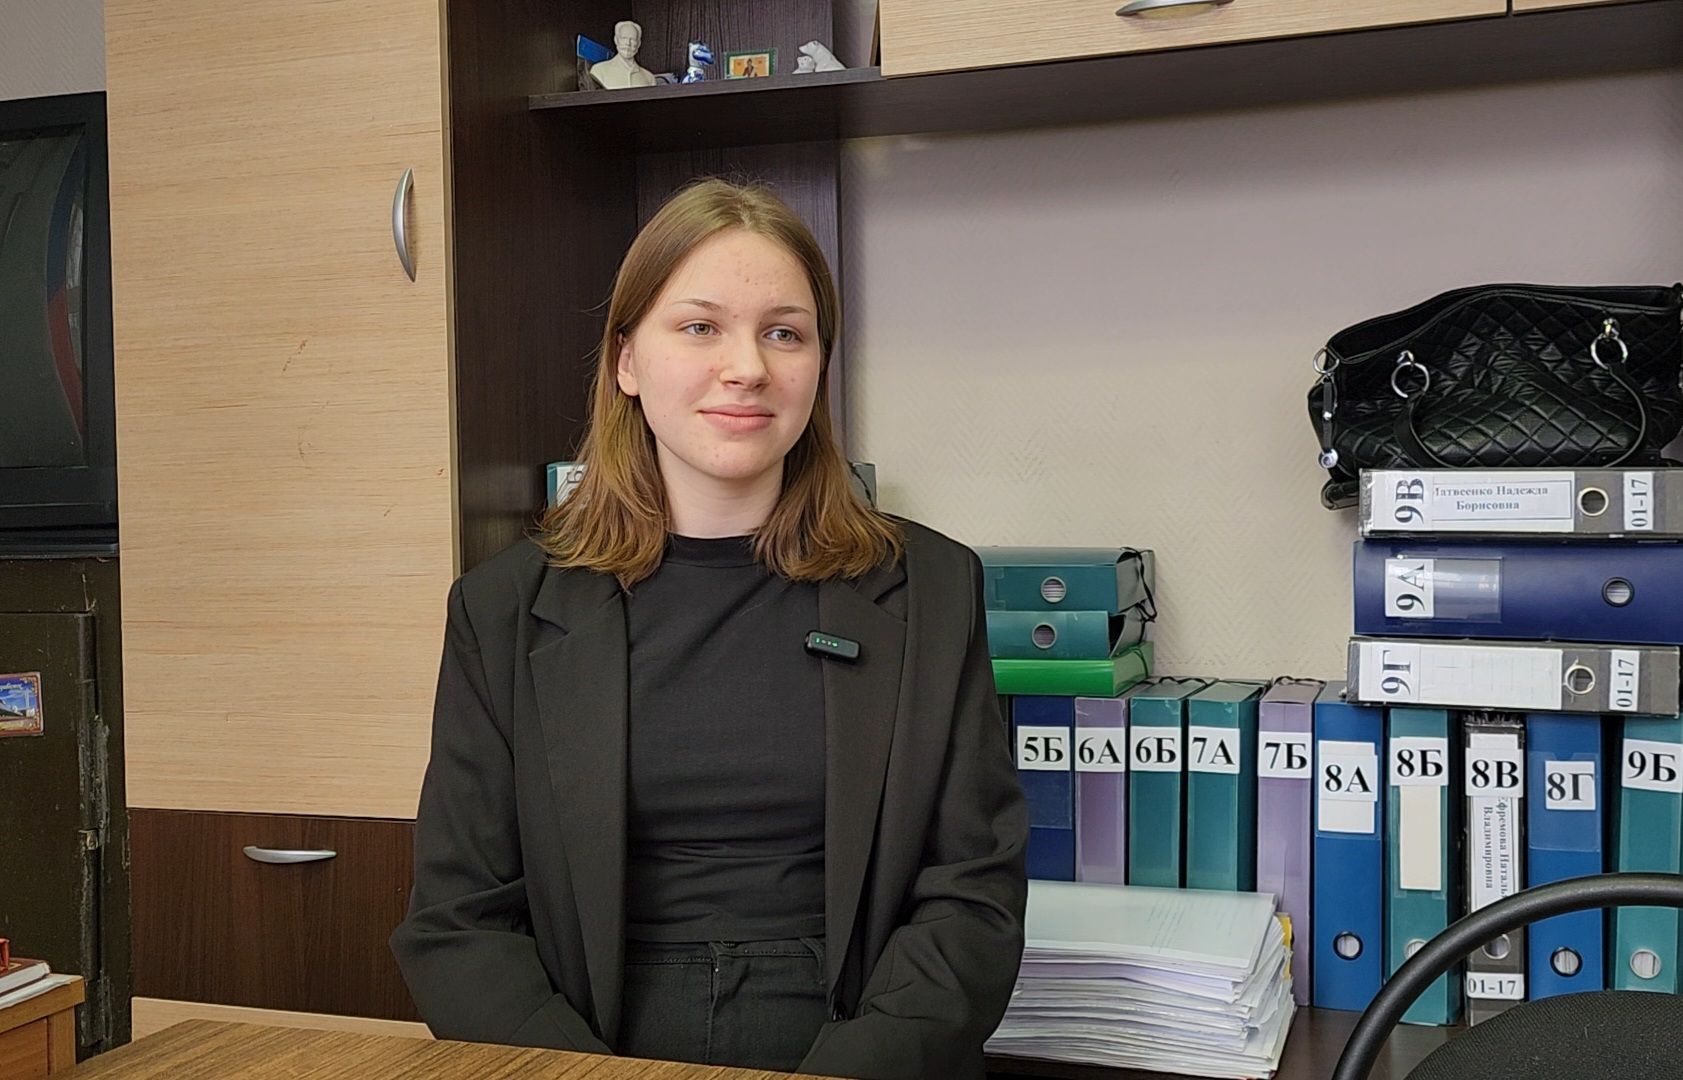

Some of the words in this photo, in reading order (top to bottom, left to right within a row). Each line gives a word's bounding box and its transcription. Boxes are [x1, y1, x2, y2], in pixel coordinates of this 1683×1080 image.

[1394, 478, 1424, 524] 9В
[1496, 485, 1548, 497] Надежда
[1631, 478, 1648, 528] 01-17
[1456, 500, 1519, 512] Борисовна
[1396, 564, 1426, 611] 9А
[1381, 650, 1412, 695] 9Г
[1616, 658, 1635, 708] 01-17
[1023, 736, 1064, 763] 5Б
[1078, 737, 1122, 764] 6А
[1135, 737, 1177, 764] 6Б
[1192, 737, 1236, 765] 7А
[1264, 742, 1308, 770] 7Б
[1396, 749, 1444, 778] 8Б
[1324, 764, 1373, 793] 8А
[1471, 759, 1519, 788] 8В
[1627, 750, 1677, 782] 9Б
[1547, 773, 1594, 801] 8Г
[1482, 806, 1493, 889] Владимировна
[1467, 978, 1517, 995] 01-17
